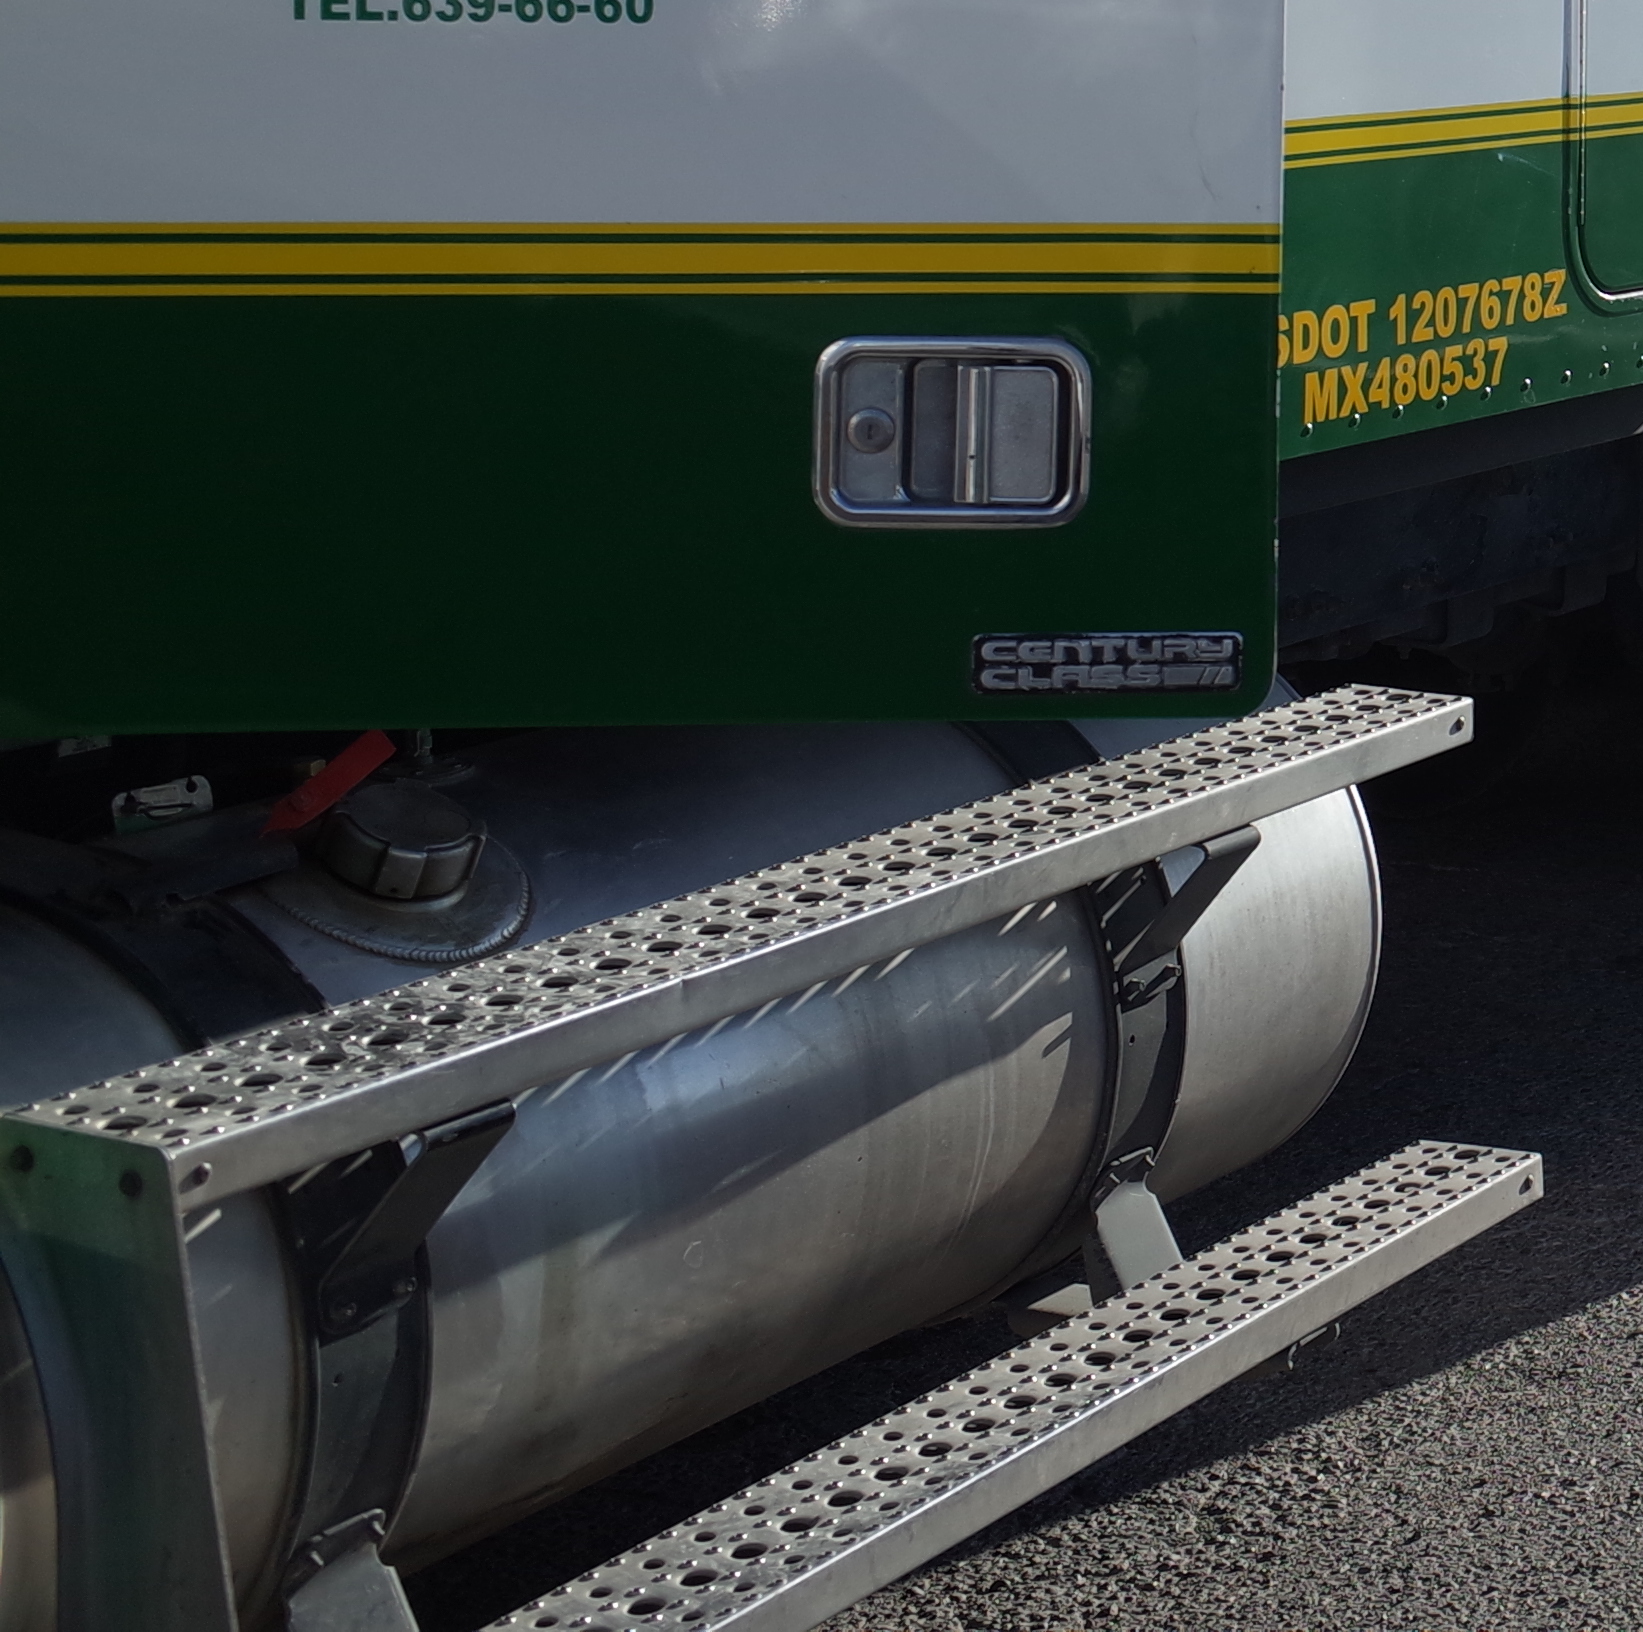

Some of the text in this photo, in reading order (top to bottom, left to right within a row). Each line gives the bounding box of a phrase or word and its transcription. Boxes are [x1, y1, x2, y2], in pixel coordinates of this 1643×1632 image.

[1389, 268, 1568, 346] 1207678Z
[1303, 336, 1509, 425] MX480537
[980, 637, 1234, 664] CENTURY
[980, 664, 1162, 691] CLASS
